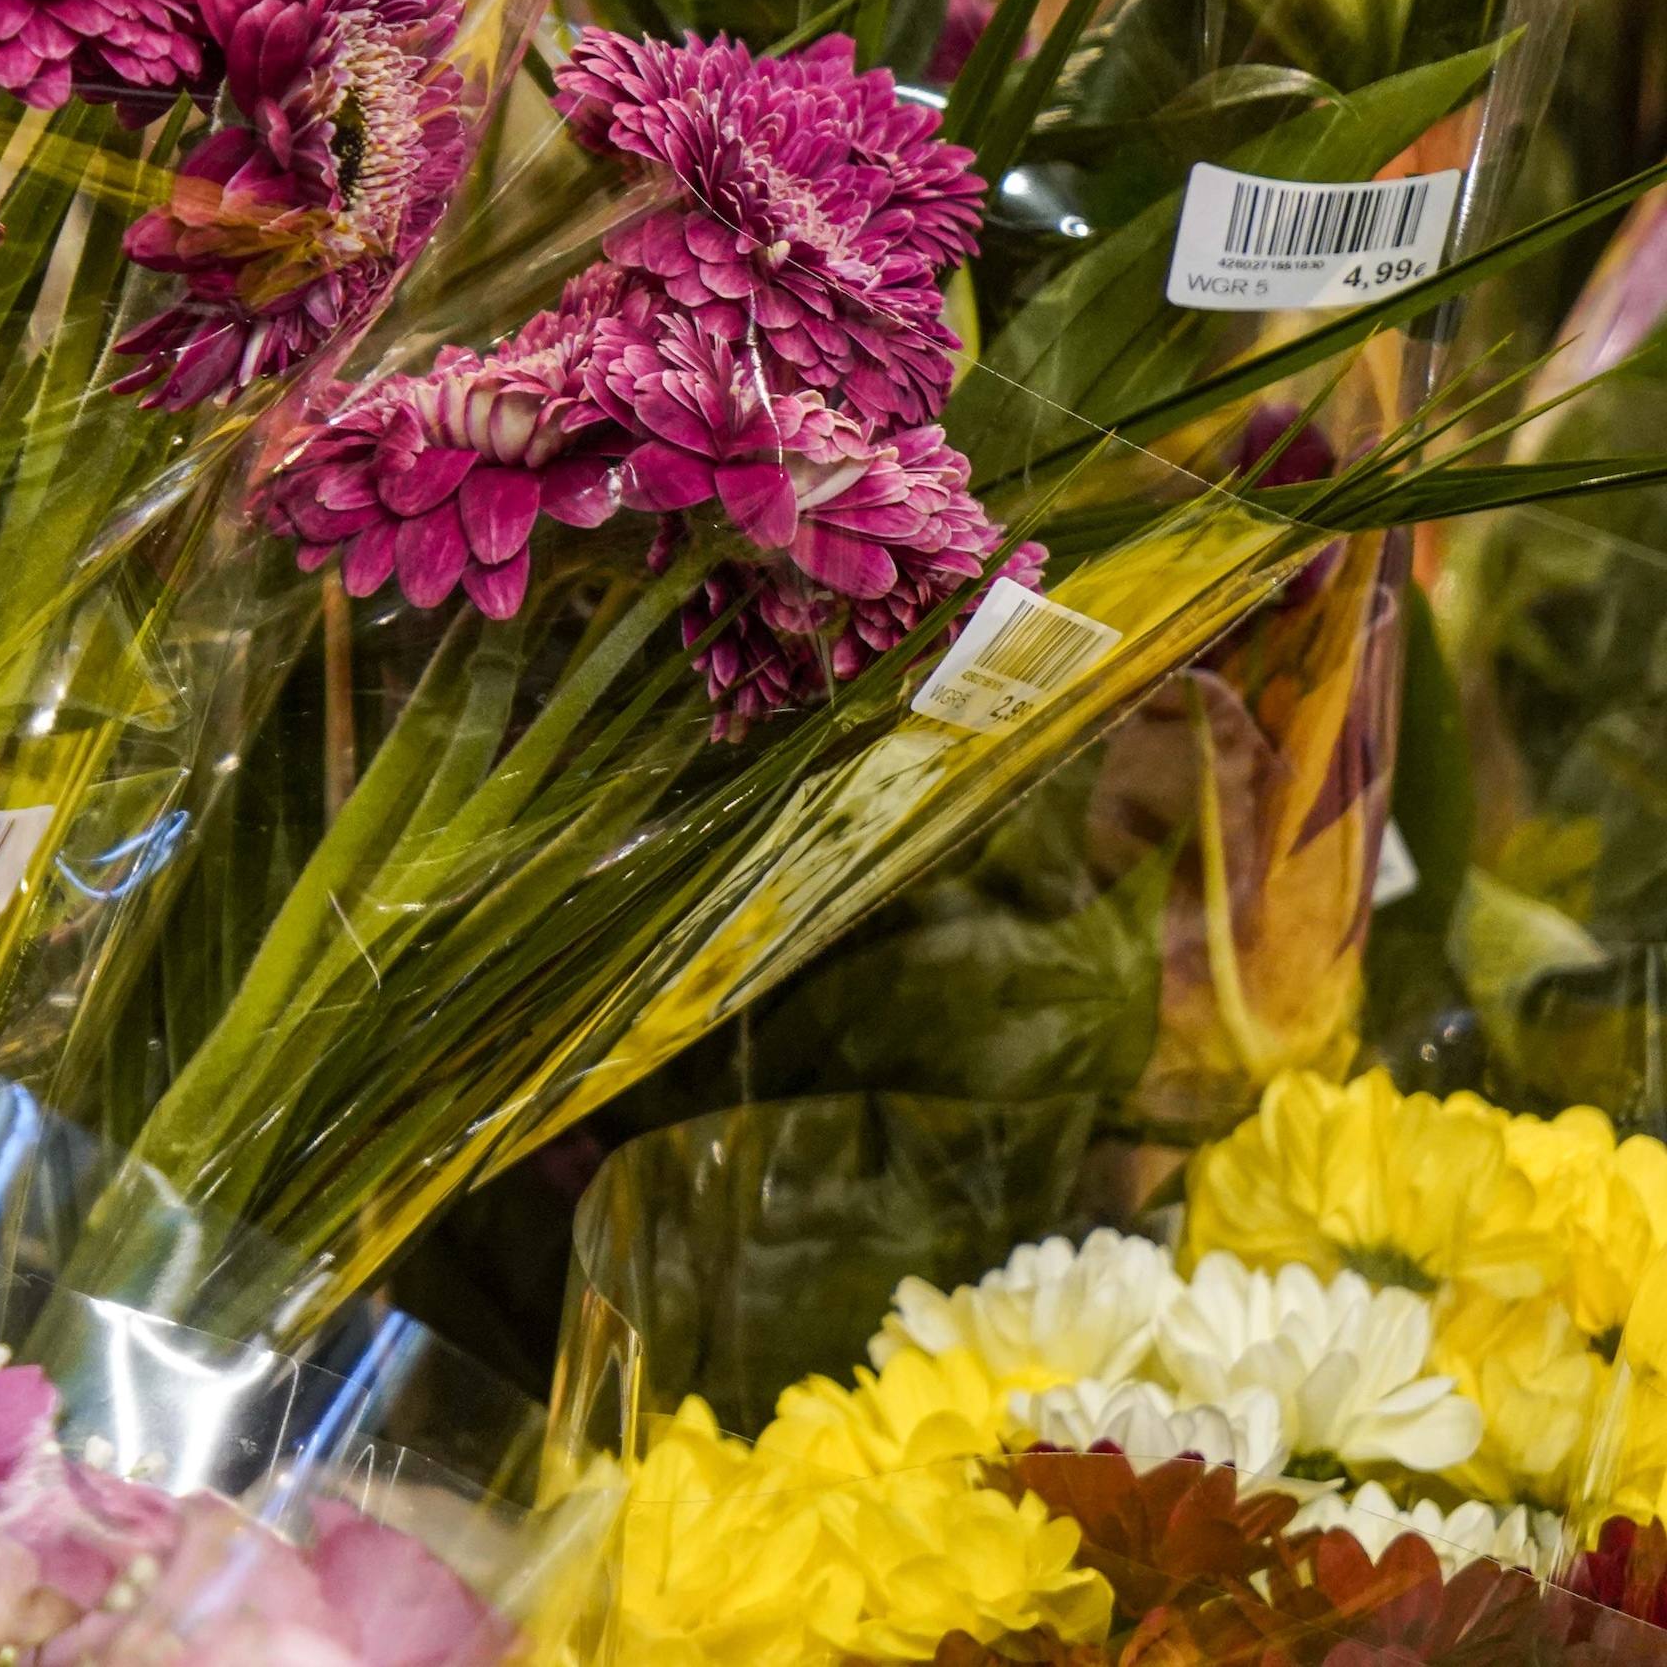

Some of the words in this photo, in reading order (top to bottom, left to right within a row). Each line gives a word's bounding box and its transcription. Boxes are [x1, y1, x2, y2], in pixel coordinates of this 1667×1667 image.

[1187, 273, 1248, 295] WGR
[1254, 278, 1269, 293] 5
[1343, 258, 1428, 289] 4,99€
